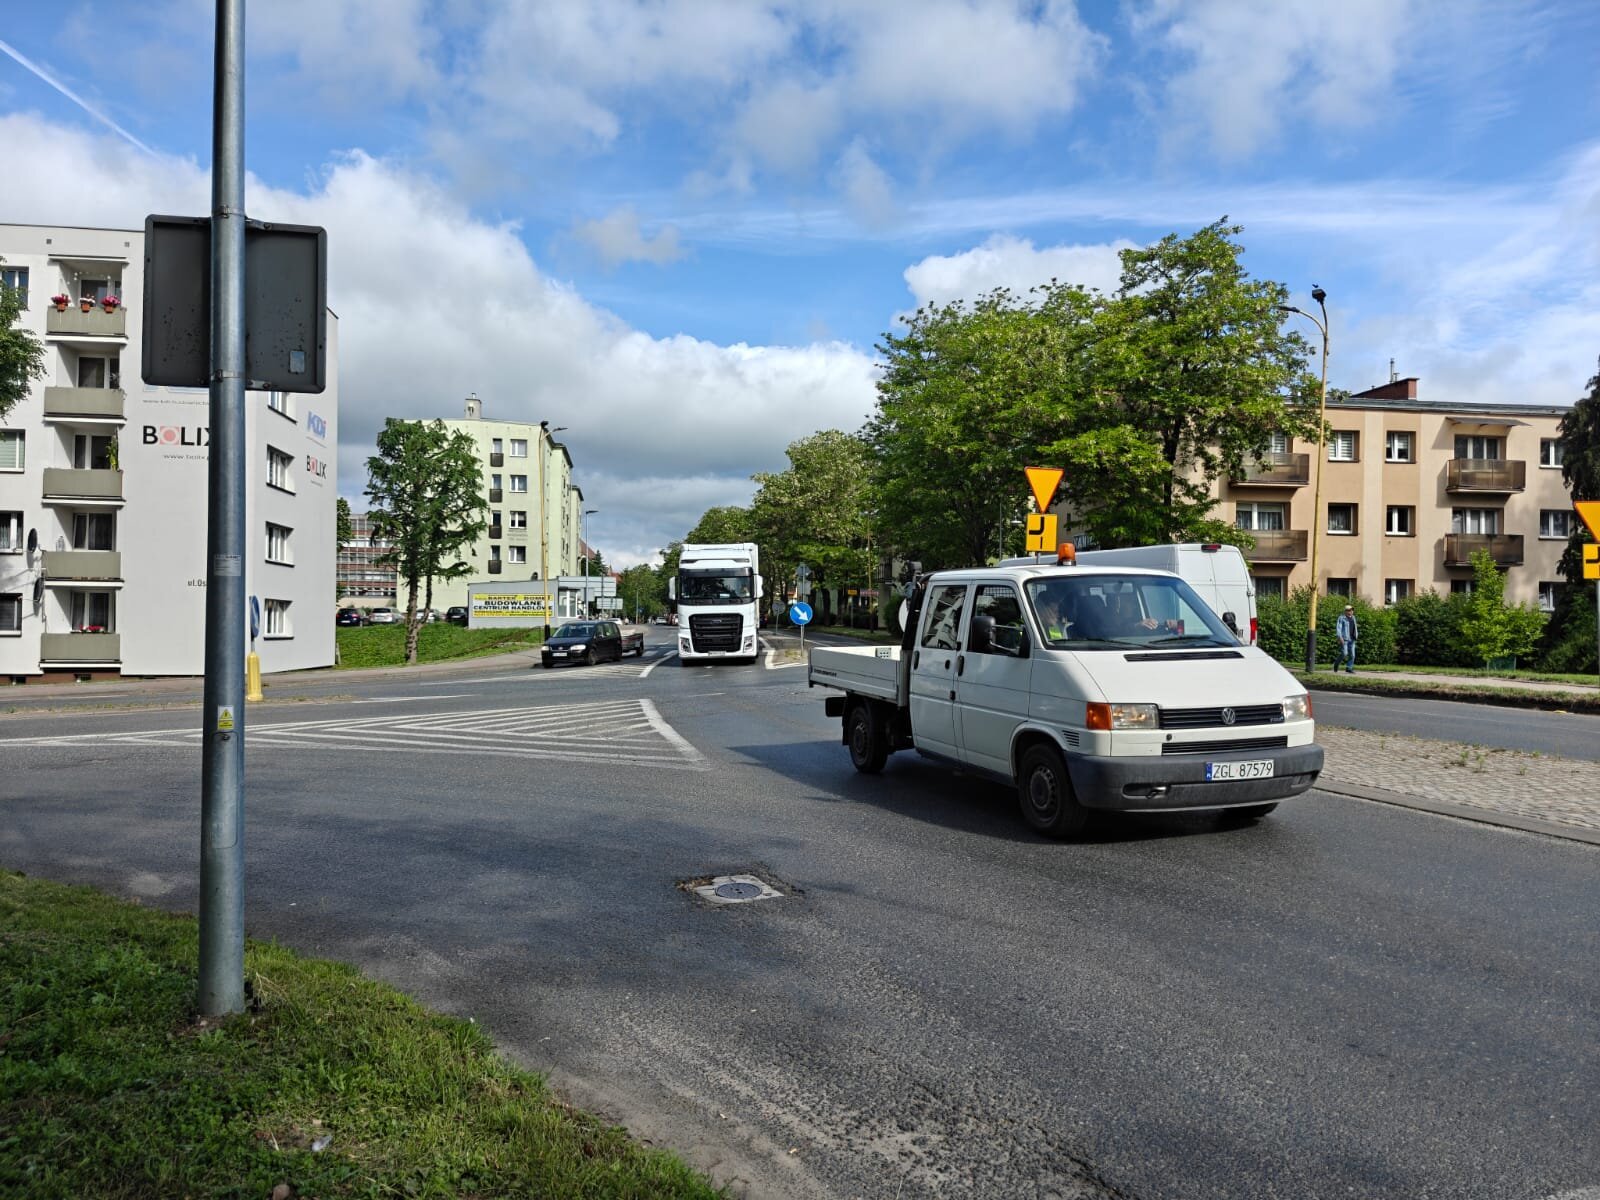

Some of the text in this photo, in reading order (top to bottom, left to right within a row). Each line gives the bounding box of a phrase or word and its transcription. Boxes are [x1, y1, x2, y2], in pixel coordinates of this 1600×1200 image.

[143, 425, 209, 447] BOLI
[1213, 762, 1273, 779] ZGL 87579
